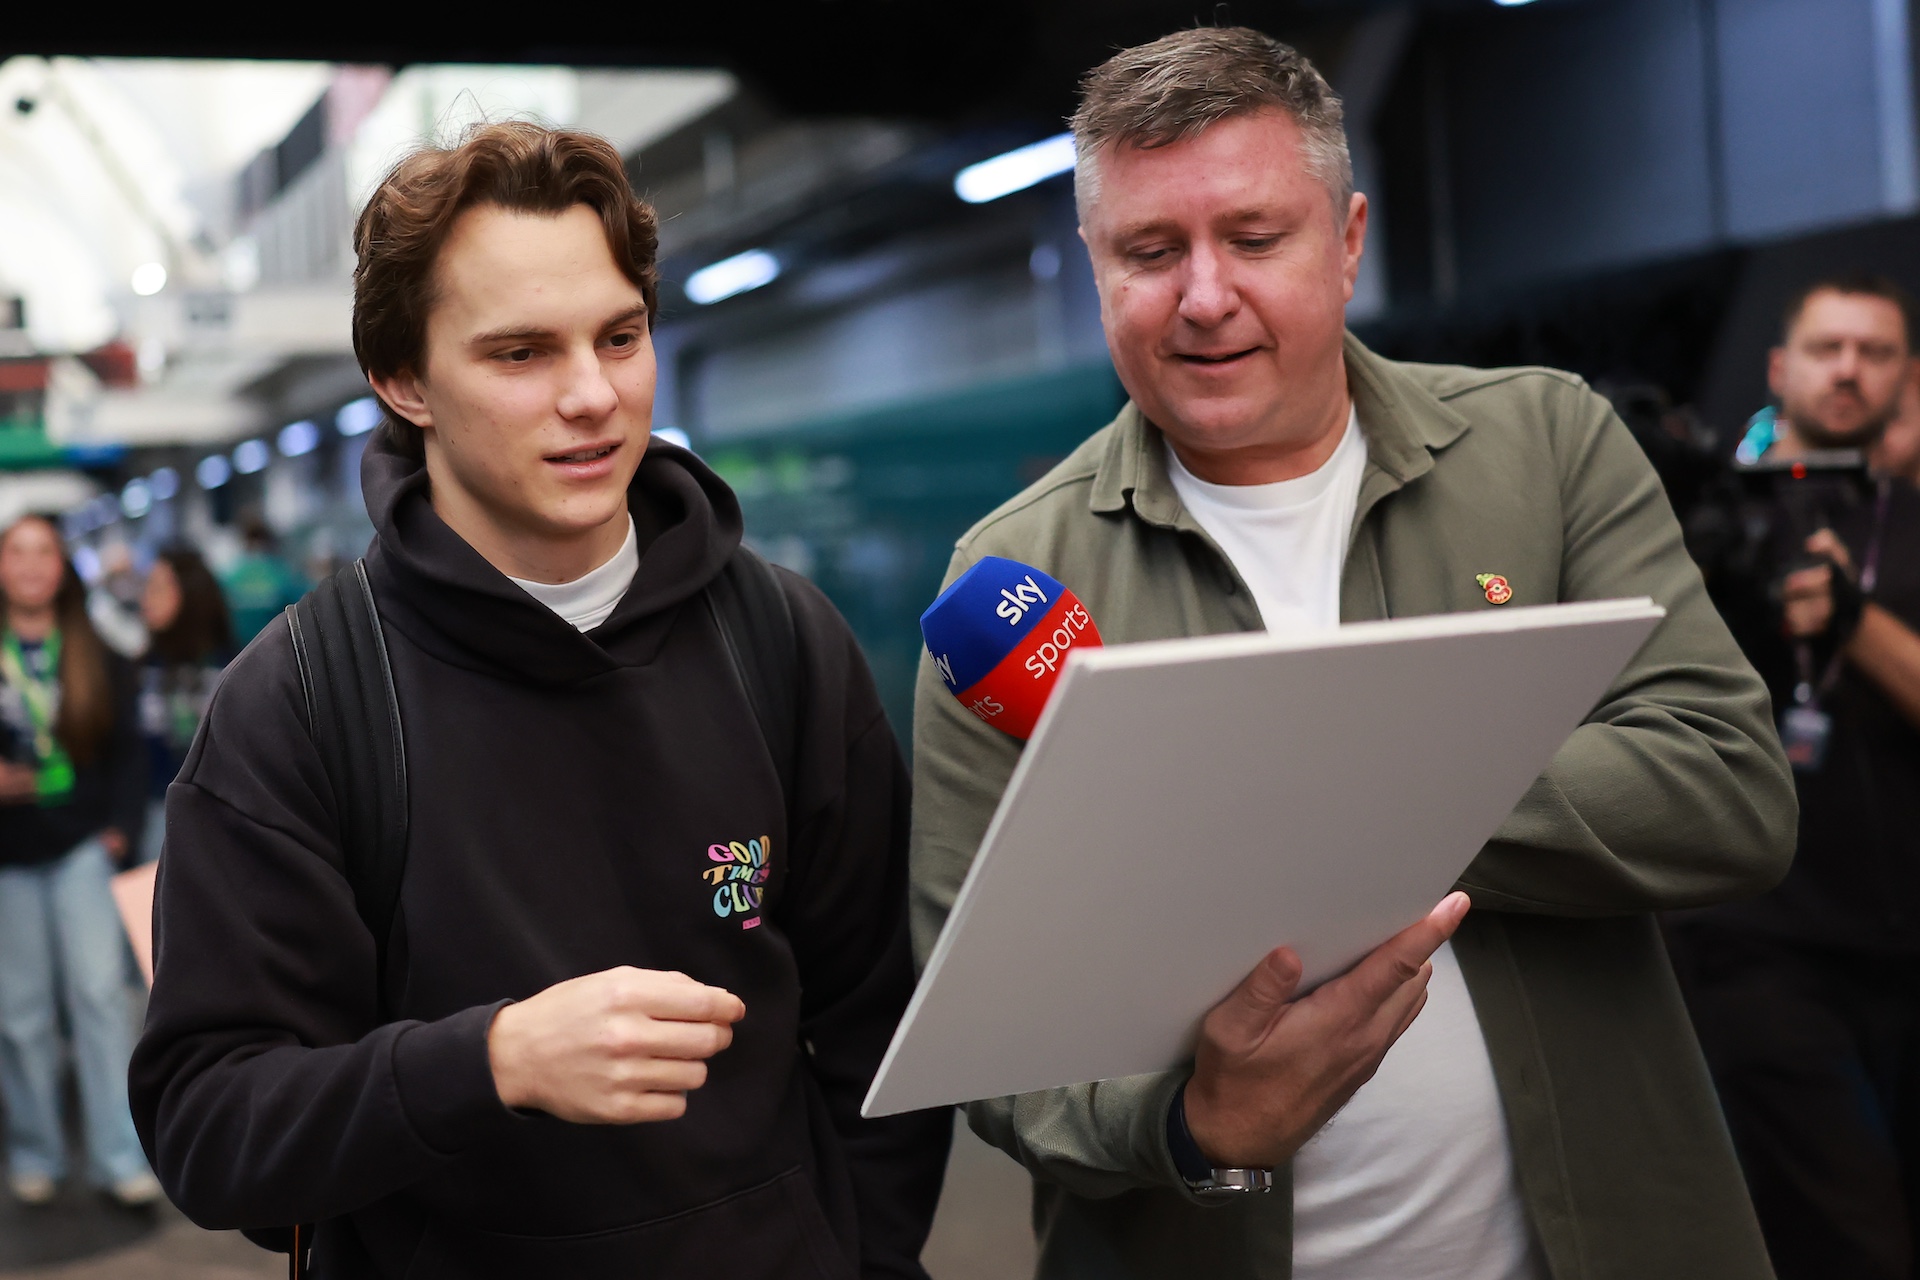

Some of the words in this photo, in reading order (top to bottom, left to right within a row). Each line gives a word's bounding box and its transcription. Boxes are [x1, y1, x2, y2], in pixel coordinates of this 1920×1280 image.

[996, 575, 1048, 626] sky
[1025, 603, 1089, 680] sports
[707, 835, 771, 869] GOOD
